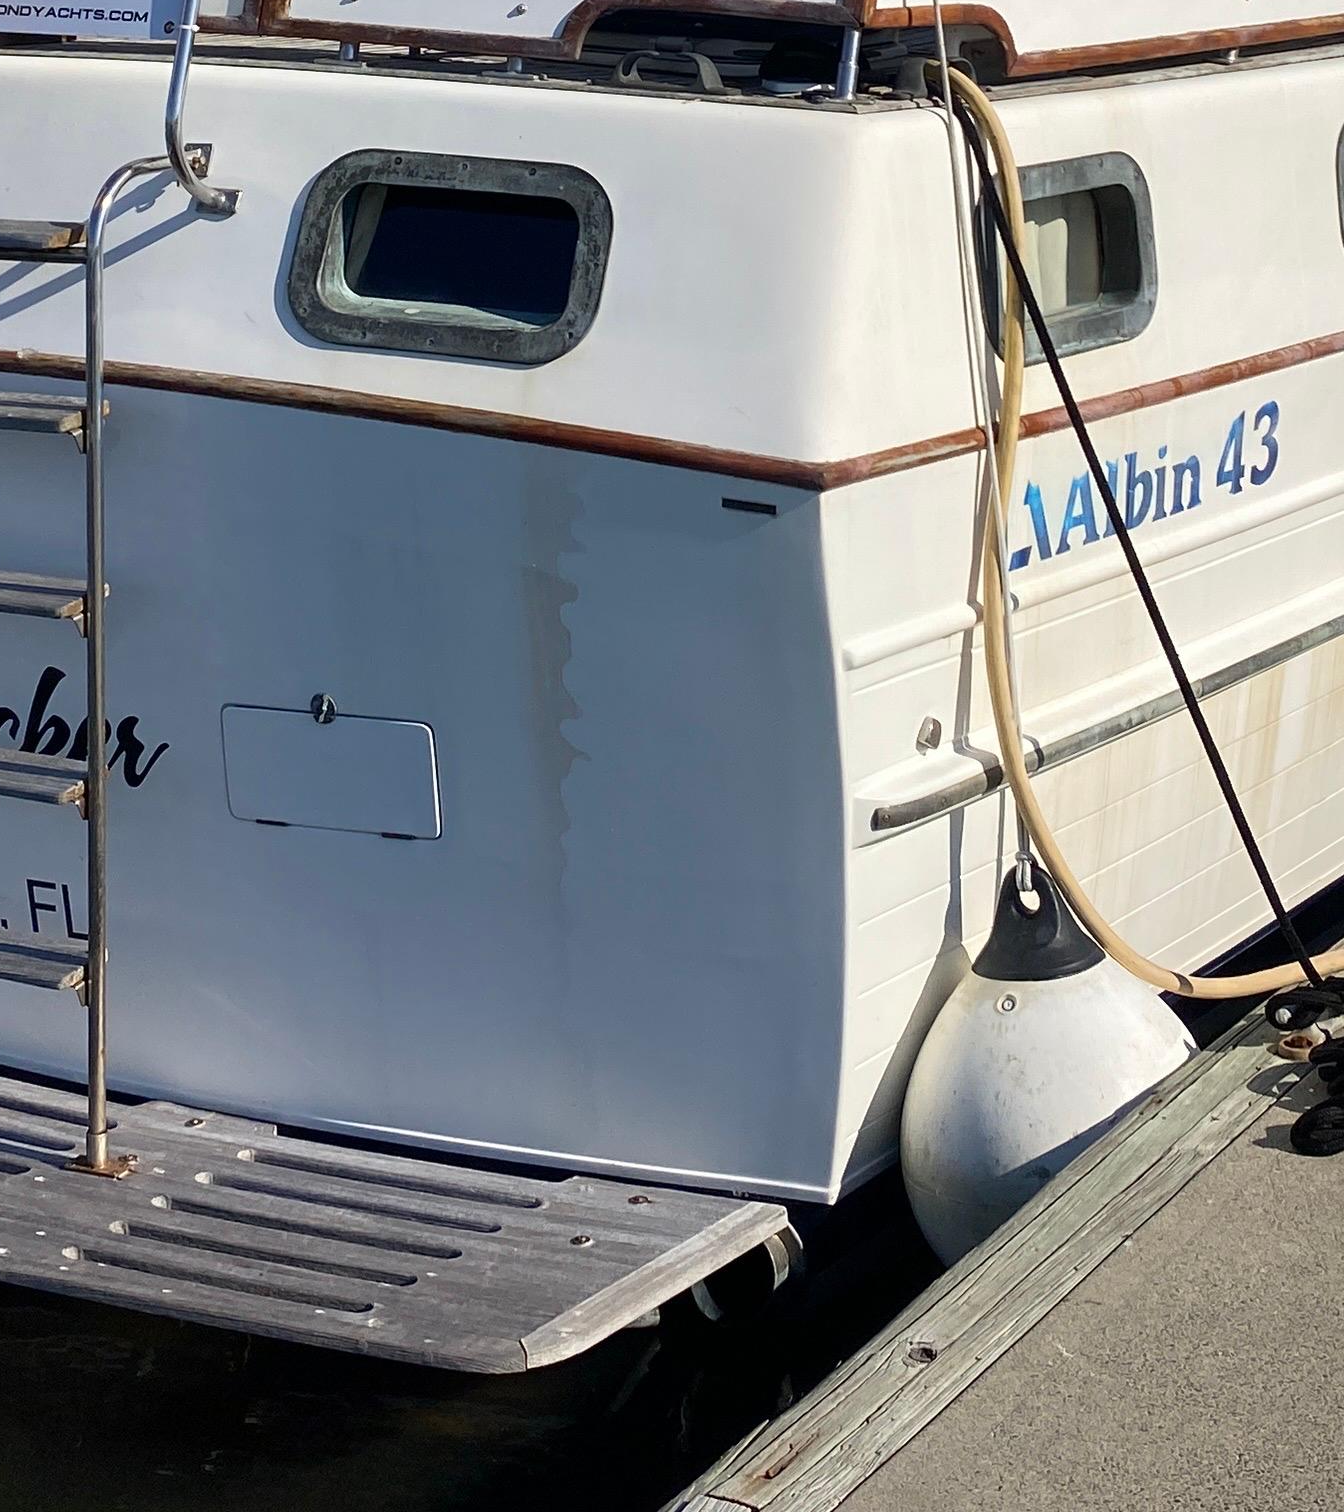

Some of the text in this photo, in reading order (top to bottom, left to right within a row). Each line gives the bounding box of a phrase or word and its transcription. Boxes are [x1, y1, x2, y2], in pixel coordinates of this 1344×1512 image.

[1055, 399, 1281, 556] Albin 43
[25, 878, 90, 941] FL
